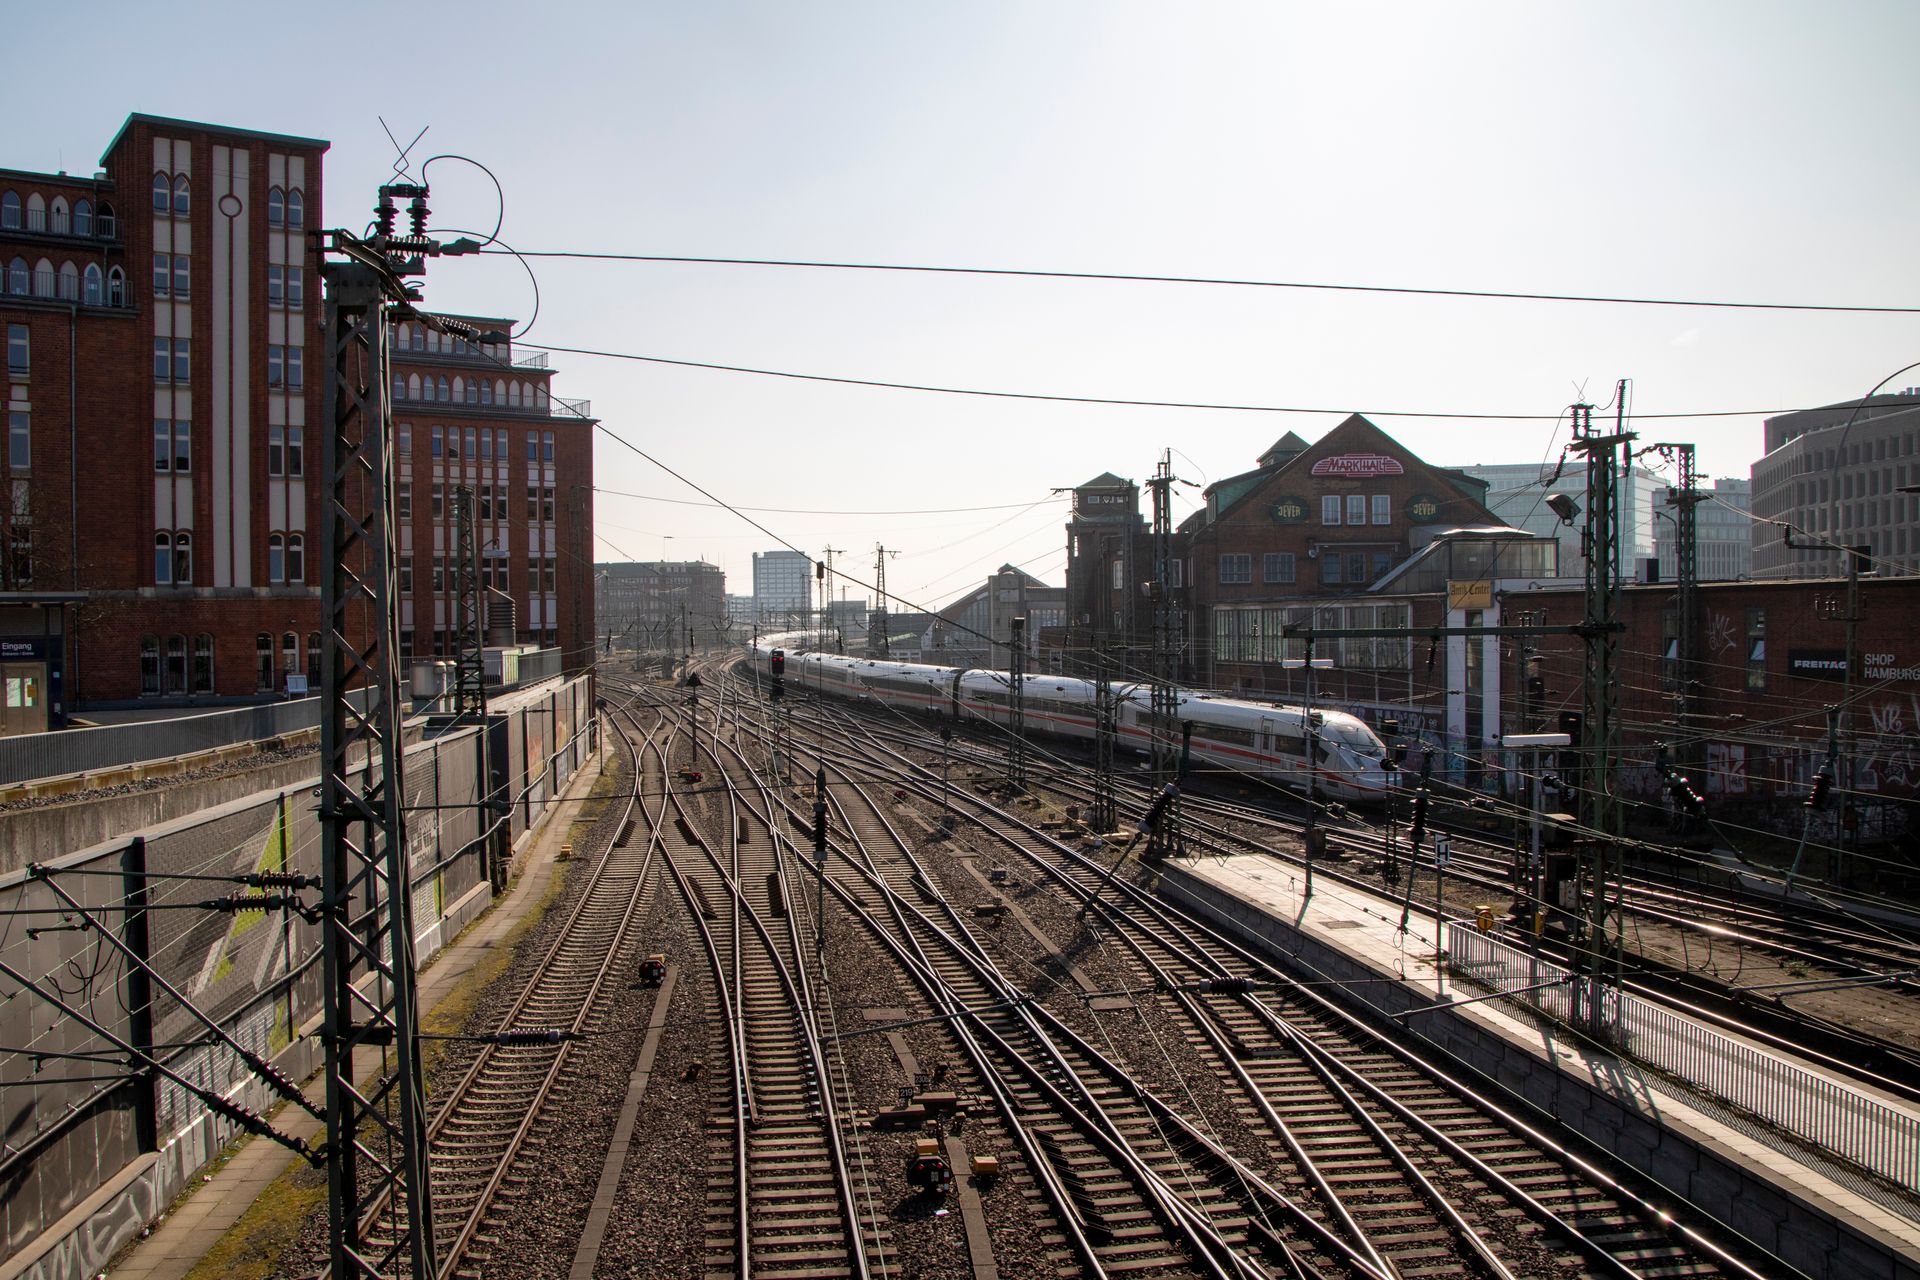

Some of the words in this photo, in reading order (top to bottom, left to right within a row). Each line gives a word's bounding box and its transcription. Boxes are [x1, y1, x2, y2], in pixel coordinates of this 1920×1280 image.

[1278, 504, 1301, 518] JEVER
[1413, 503, 1436, 516] JEVER
[2, 642, 32, 652] Eingang
[1794, 659, 1847, 669] FREITAG
[1864, 653, 1895, 665] SHOP
[1864, 667, 1920, 681] HAMBURG
[1436, 844, 1449, 863] H
[900, 1088, 913, 1097] 219
